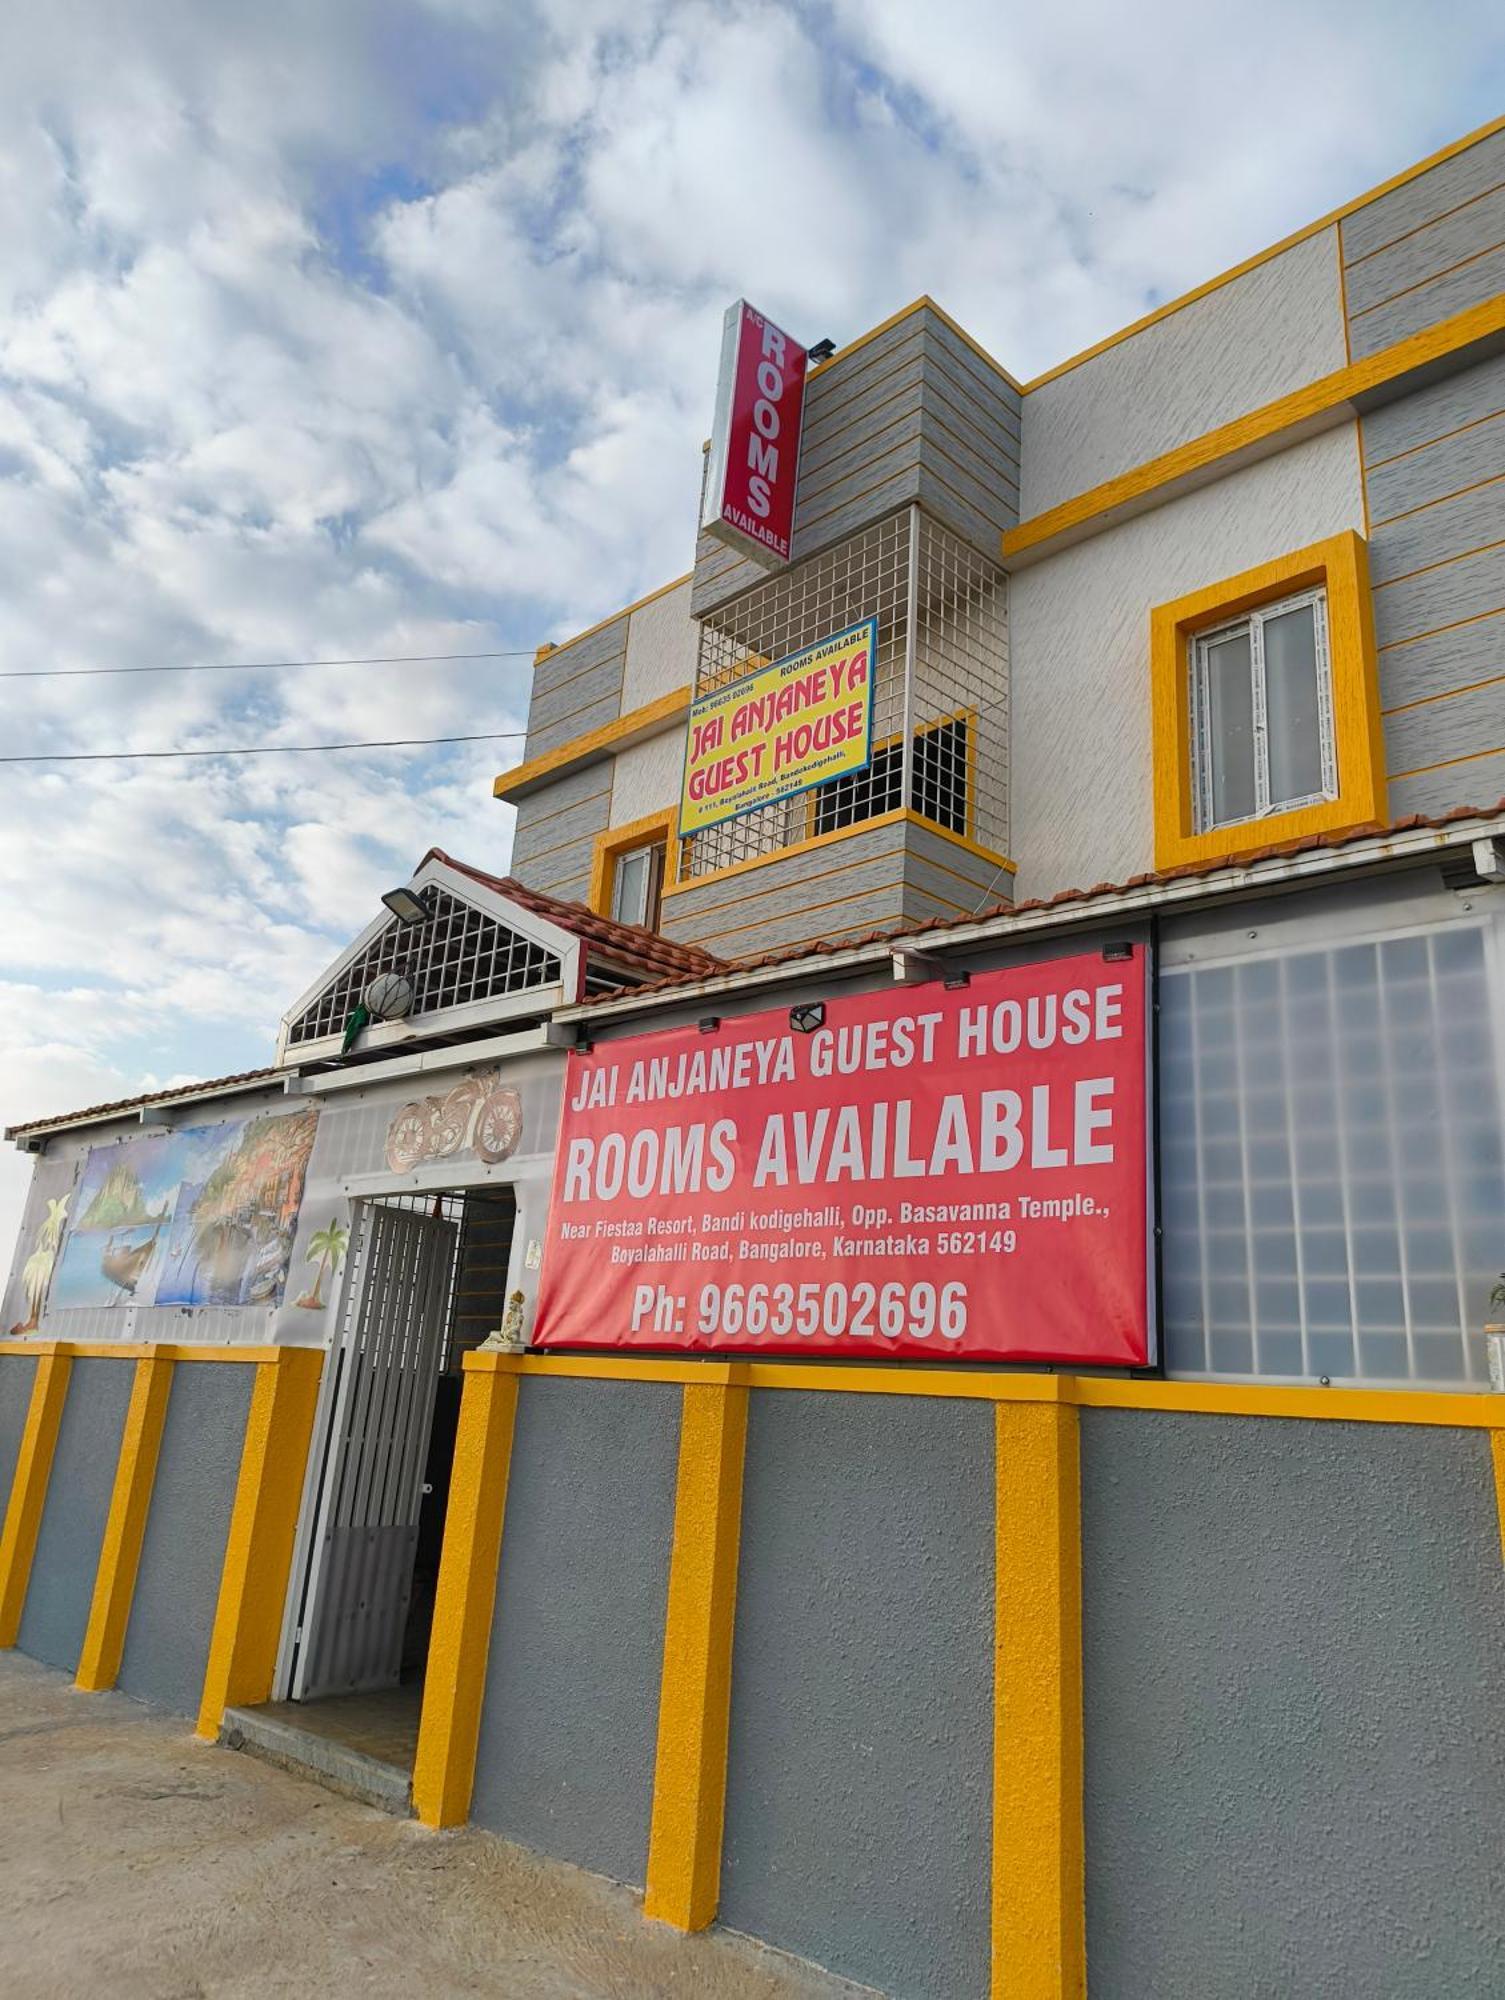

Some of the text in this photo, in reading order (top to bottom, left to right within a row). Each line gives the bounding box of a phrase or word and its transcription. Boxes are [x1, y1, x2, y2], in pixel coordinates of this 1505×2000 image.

[747, 322, 786, 518] ROOMS
[723, 503, 788, 555] AVAILABLE
[780, 628, 869, 678] ROOMS AVAILABLE
[690, 650, 868, 766] JAI ANJANEYA
[688, 701, 864, 801] GUEST HOUSE
[571, 984, 1124, 1112] JAI ANJANEYA GUEST HOUSE
[563, 1076, 1115, 1204] ROOMS AVAILABLE
[561, 1193, 1109, 1240] Near Fiestaa Resort, Bandi kodigehalli, Opp. Basavanna Temple.,
[611, 1230, 1017, 1266] Boyalahalli Road, Bangalore, Karnataka 562149
[631, 1281, 968, 1339] Ph: 9663502696
